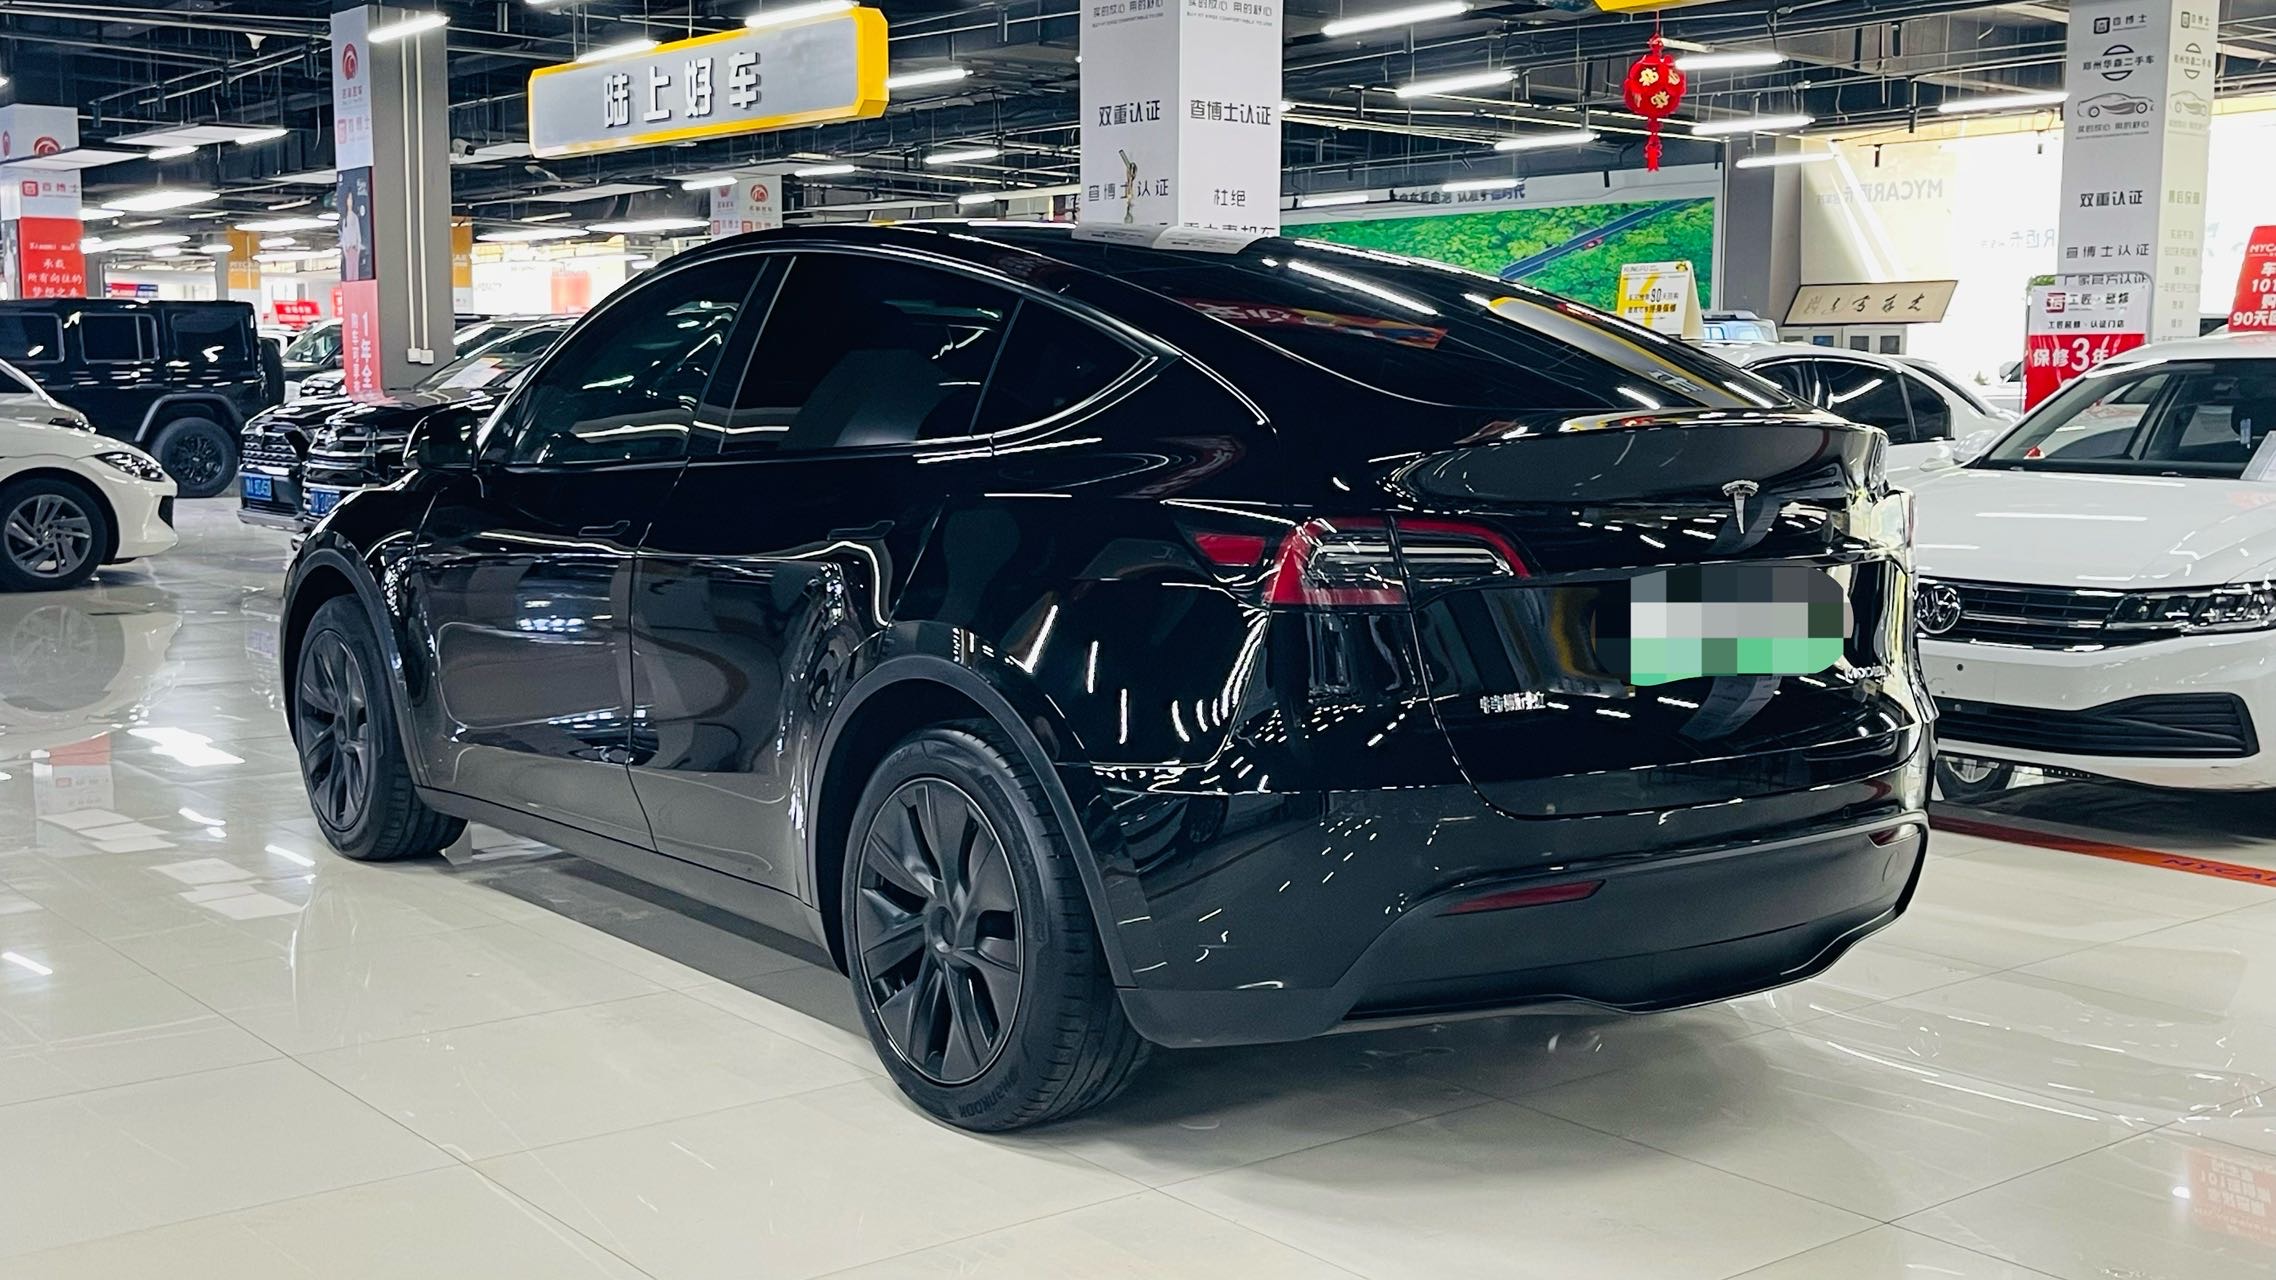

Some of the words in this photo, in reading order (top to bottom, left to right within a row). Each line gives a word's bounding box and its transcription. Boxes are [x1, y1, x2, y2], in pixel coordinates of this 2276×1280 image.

[603, 51, 758, 128] 陆上好车
[1098, 99, 1161, 128] 双重认证
[1189, 99, 1272, 126] 查博士认证
[1213, 188, 1246, 208] 杜绝
[2079, 190, 2144, 208] 双重认证
[2033, 337, 2110, 372] 保修3年
